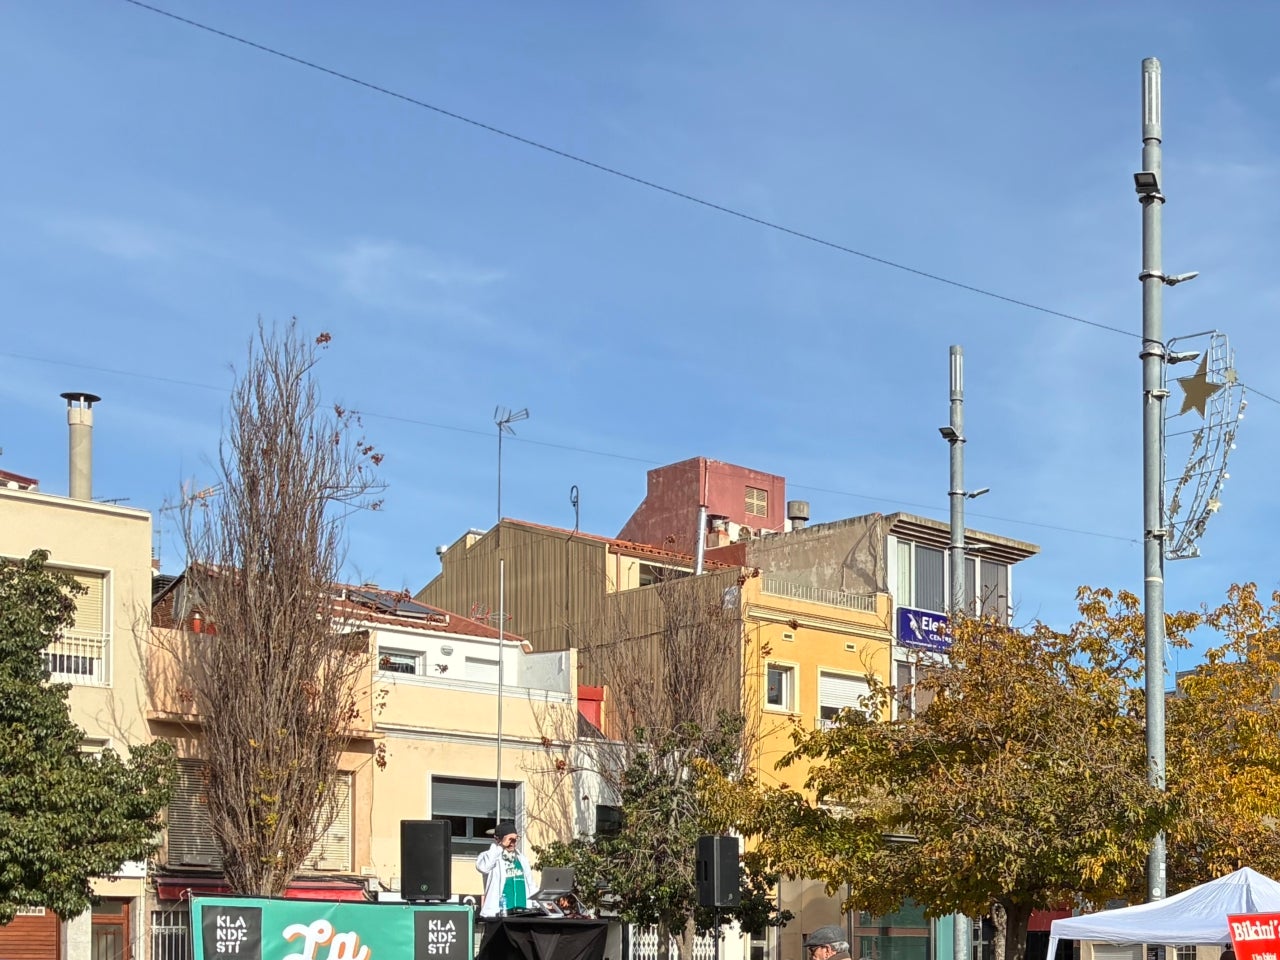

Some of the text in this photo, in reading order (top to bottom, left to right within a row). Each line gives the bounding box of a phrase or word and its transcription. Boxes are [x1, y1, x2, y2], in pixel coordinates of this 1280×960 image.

[216, 915, 246, 928] KLA
[428, 919, 456, 931] KLA
[216, 928, 248, 941] NDE
[428, 931, 457, 943] NDE
[216, 940, 241, 954] STÍ
[427, 942, 450, 955] STÍ
